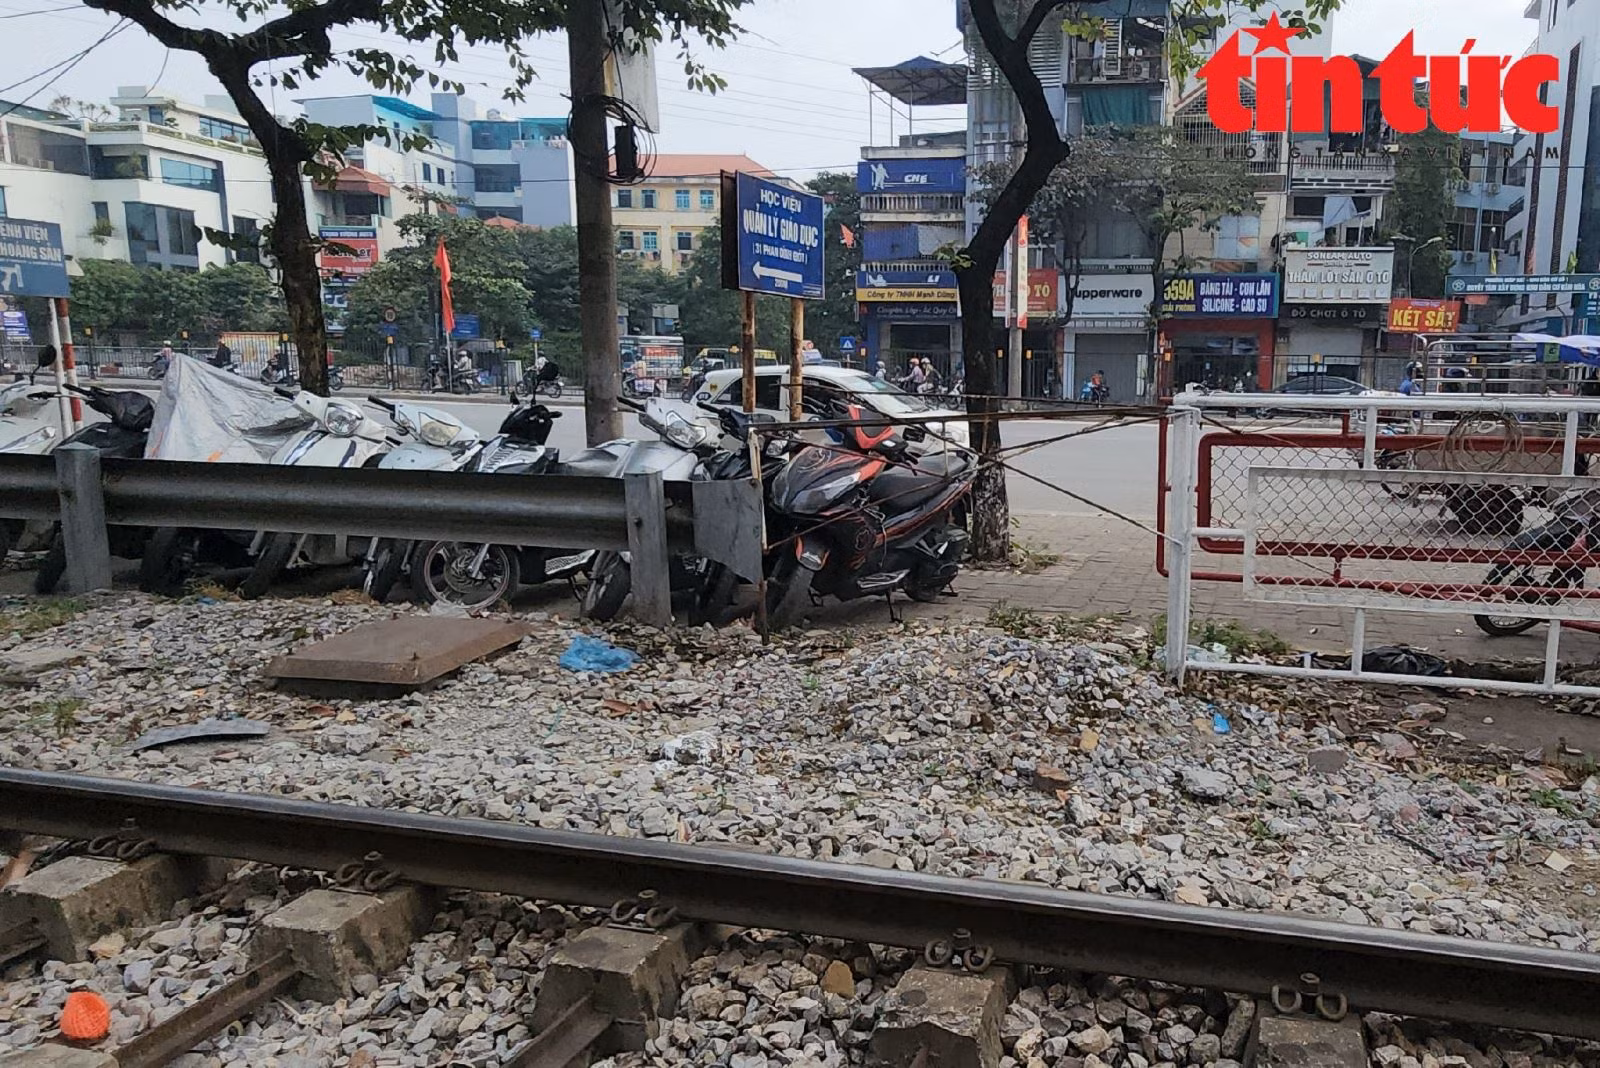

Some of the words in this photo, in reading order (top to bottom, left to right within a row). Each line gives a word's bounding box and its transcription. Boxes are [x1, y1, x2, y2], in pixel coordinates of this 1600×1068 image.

[761, 189, 781, 208] HỌC
[781, 195, 802, 213] VIỆN
[0, 222, 22, 240] ỆNH
[23, 224, 49, 243] VIỆN
[743, 203, 768, 234] QUẢN
[768, 211, 779, 238] LÝ
[780, 216, 799, 243] GIÁO
[800, 224, 818, 250] DỤC
[0, 241, 38, 260] HOÁNG
[40, 243, 62, 262] SẢN
[763, 244, 779, 258] PHAN
[867, 291, 885, 299] Công
[1034, 282, 1051, 298] TÔ
[1221, 277, 1234, 296] TẢI
[1239, 282, 1255, 296] CON
[1256, 279, 1271, 296] LĂN
[1202, 298, 1235, 312] SILICONE
[1241, 299, 1255, 312] CAO
[1257, 298, 1267, 312] SU
[1393, 305, 1422, 327] KÉT
